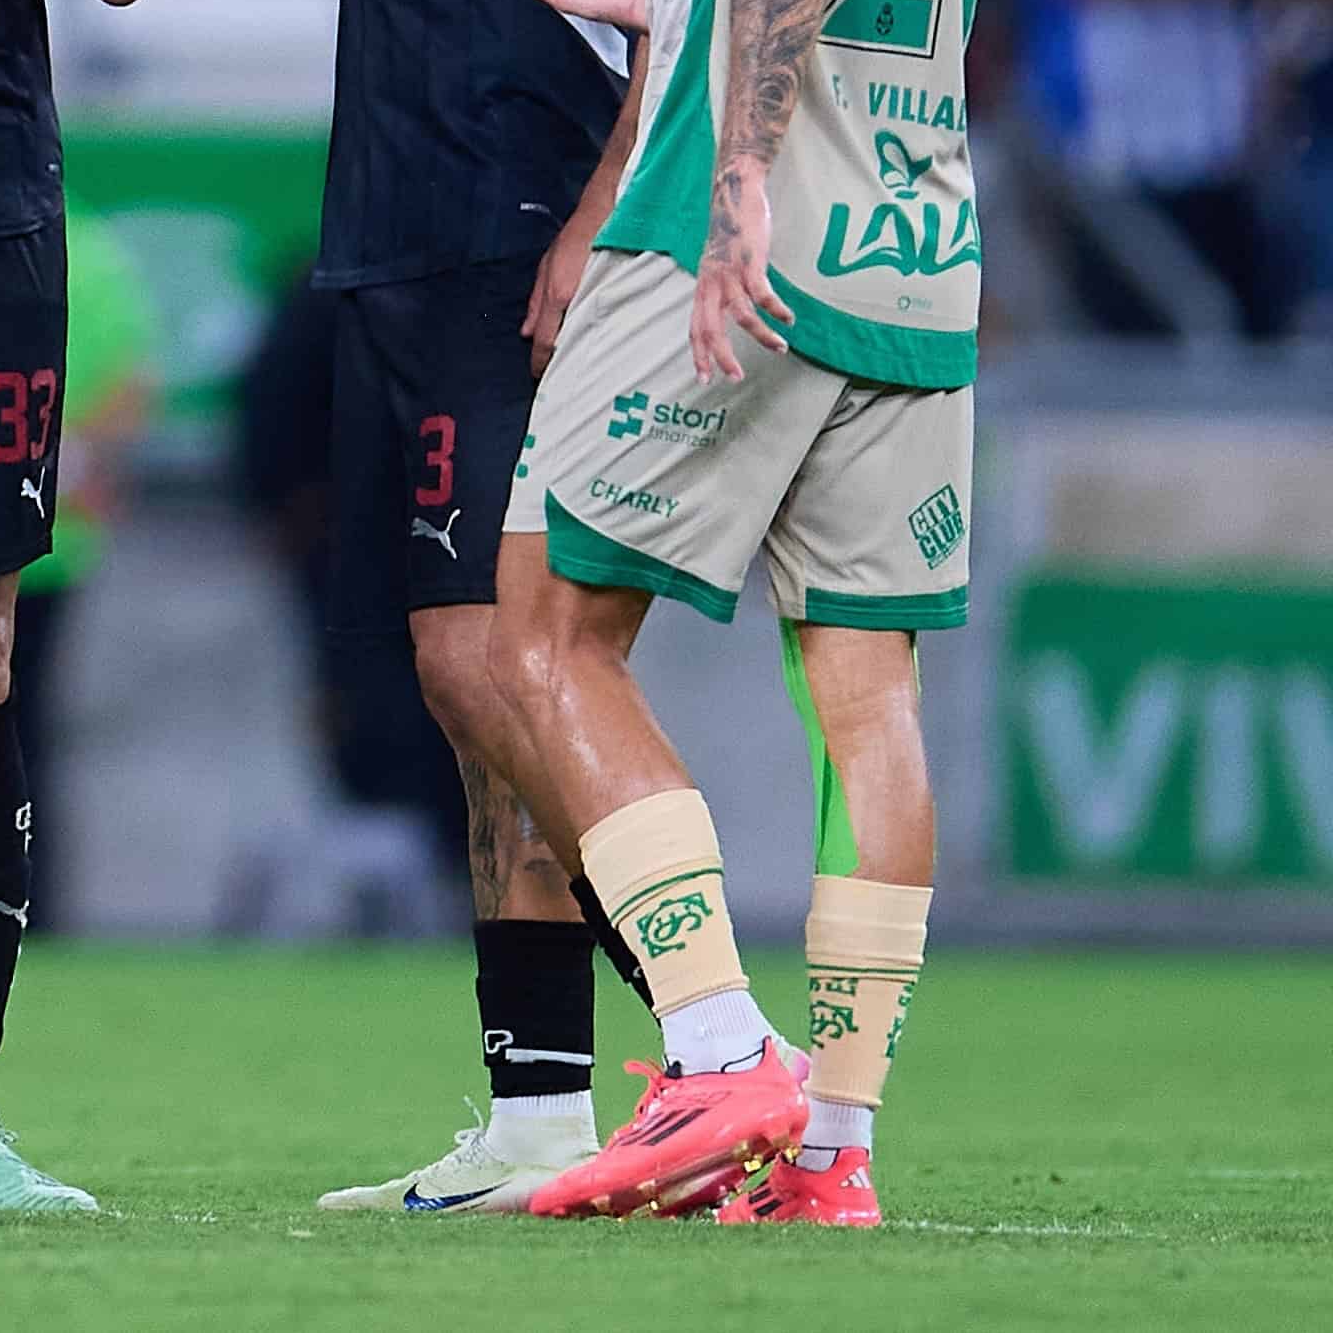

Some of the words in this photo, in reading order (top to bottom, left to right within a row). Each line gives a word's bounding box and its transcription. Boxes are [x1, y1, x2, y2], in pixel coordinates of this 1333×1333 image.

[817, 198, 982, 277] LALA
[653, 402, 726, 431] stori
[415, 414, 456, 507] 3
[590, 478, 680, 518] CHARLY
[910, 486, 960, 536] CITY
[918, 511, 965, 560] CLUB
